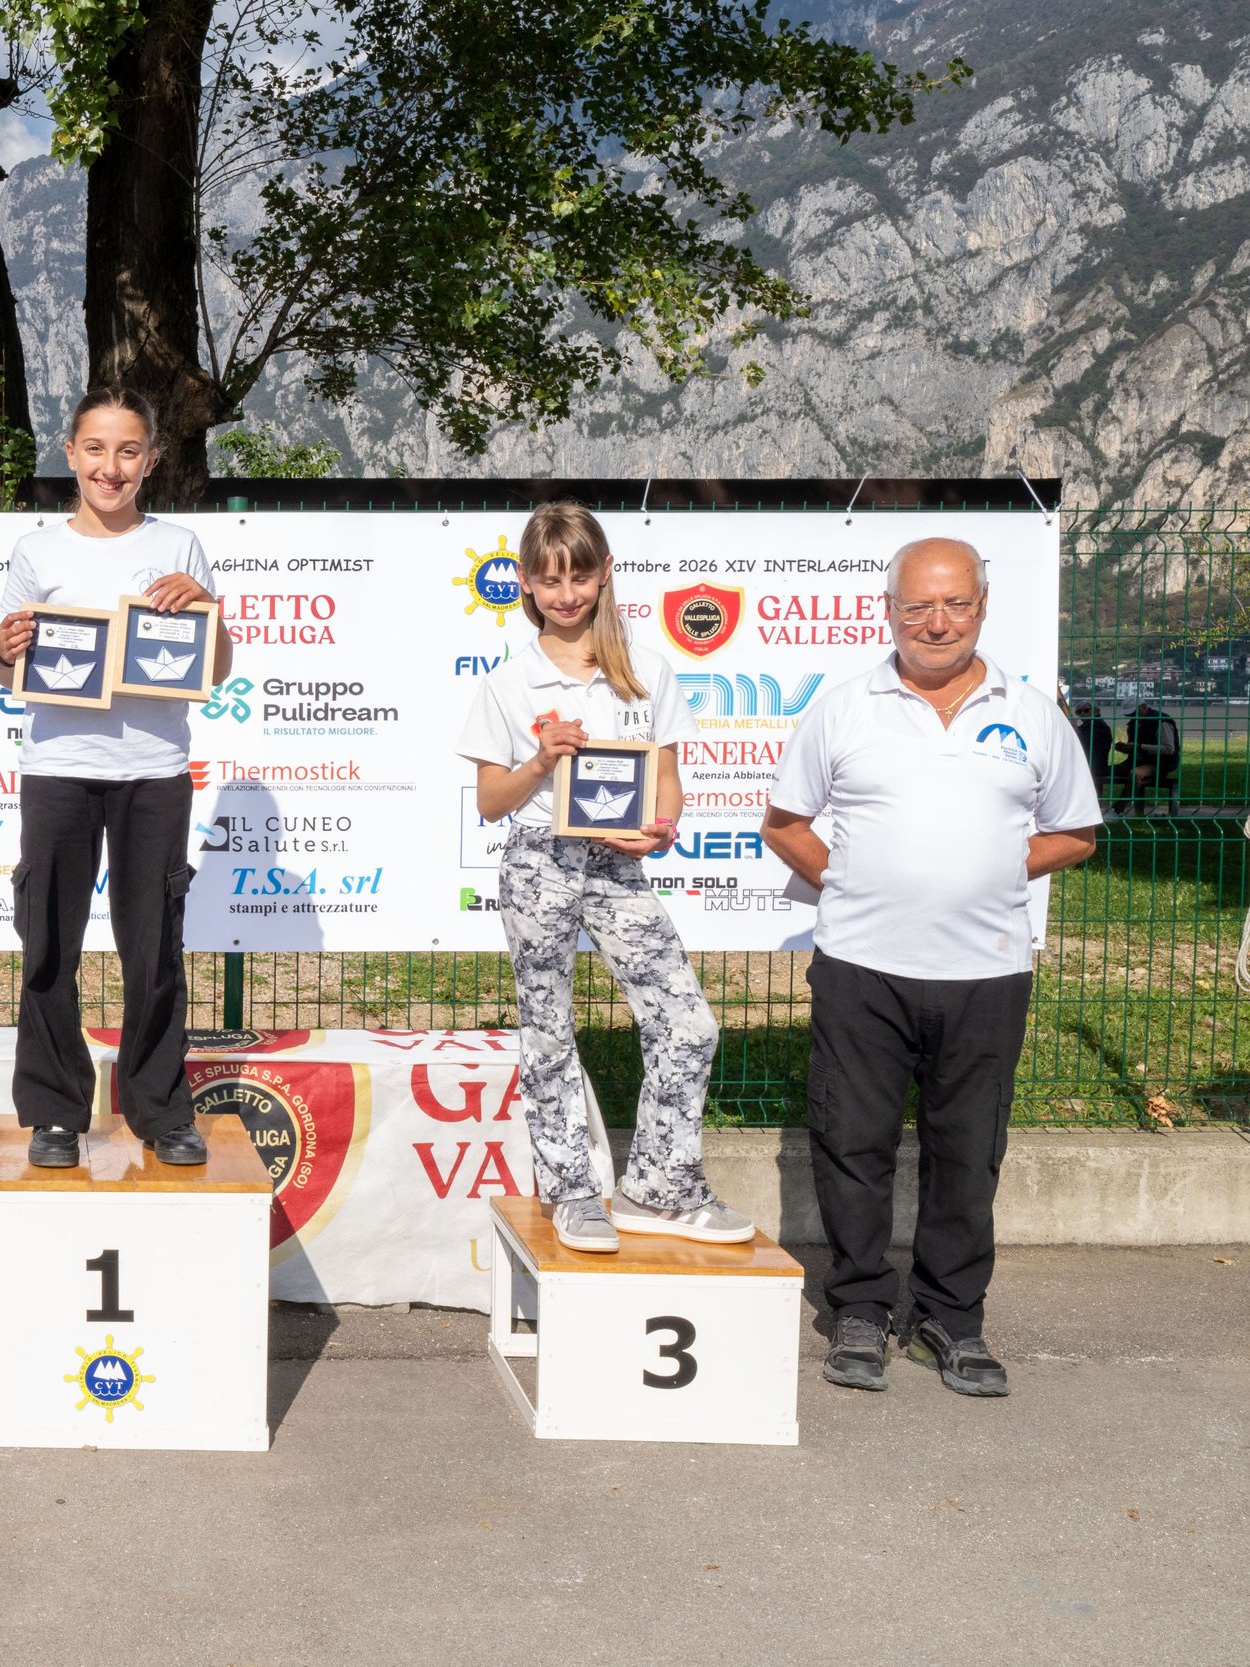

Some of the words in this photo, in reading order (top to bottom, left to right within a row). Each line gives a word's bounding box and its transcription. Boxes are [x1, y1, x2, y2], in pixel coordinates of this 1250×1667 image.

[211, 558, 280, 572] AGHINA
[287, 558, 374, 572] OPTIMIST
[613, 559, 671, 573] ottobre
[678, 559, 718, 573] 2026
[725, 559, 757, 573] XIV
[485, 584, 517, 593] CVT
[689, 601, 716, 611] GALLETTO
[227, 625, 336, 645] SPLUGA
[685, 623, 699, 637] VALLE
[700, 623, 720, 638] SPLUGA
[757, 626, 892, 645] VALLESPL
[455, 656, 501, 676] FIV
[262, 678, 365, 701] Gruppo
[263, 702, 399, 722] Pulidream
[263, 727, 272, 736] IL
[273, 727, 326, 736] RISULTATO
[328, 727, 378, 736] MIGLIORE.
[734, 719, 788, 729] METALLI
[677, 741, 785, 765] ENERA
[217, 760, 361, 781] Thermostick
[692, 771, 731, 781] Agenzia
[231, 816, 253, 832] IL
[265, 816, 352, 832] CUNEO
[231, 836, 317, 853] Salute
[230, 867, 327, 895] T.S.A.
[339, 866, 384, 895] srl
[229, 902, 277, 917] stampi
[281, 905, 289, 914] e
[292, 902, 378, 914] attrezzature
[704, 889, 792, 911] MUTE
[205, 1064, 259, 1078] SPLUGA
[261, 1069, 291, 1097] S.P.A.
[193, 1089, 272, 1115] GALLETTO
[292, 1095, 317, 1159] GORDONA
[292, 1161, 314, 1189] (SO)
[86, 1249, 135, 1323] 1
[642, 1315, 698, 1390] 3
[94, 1381, 124, 1390] CVT
